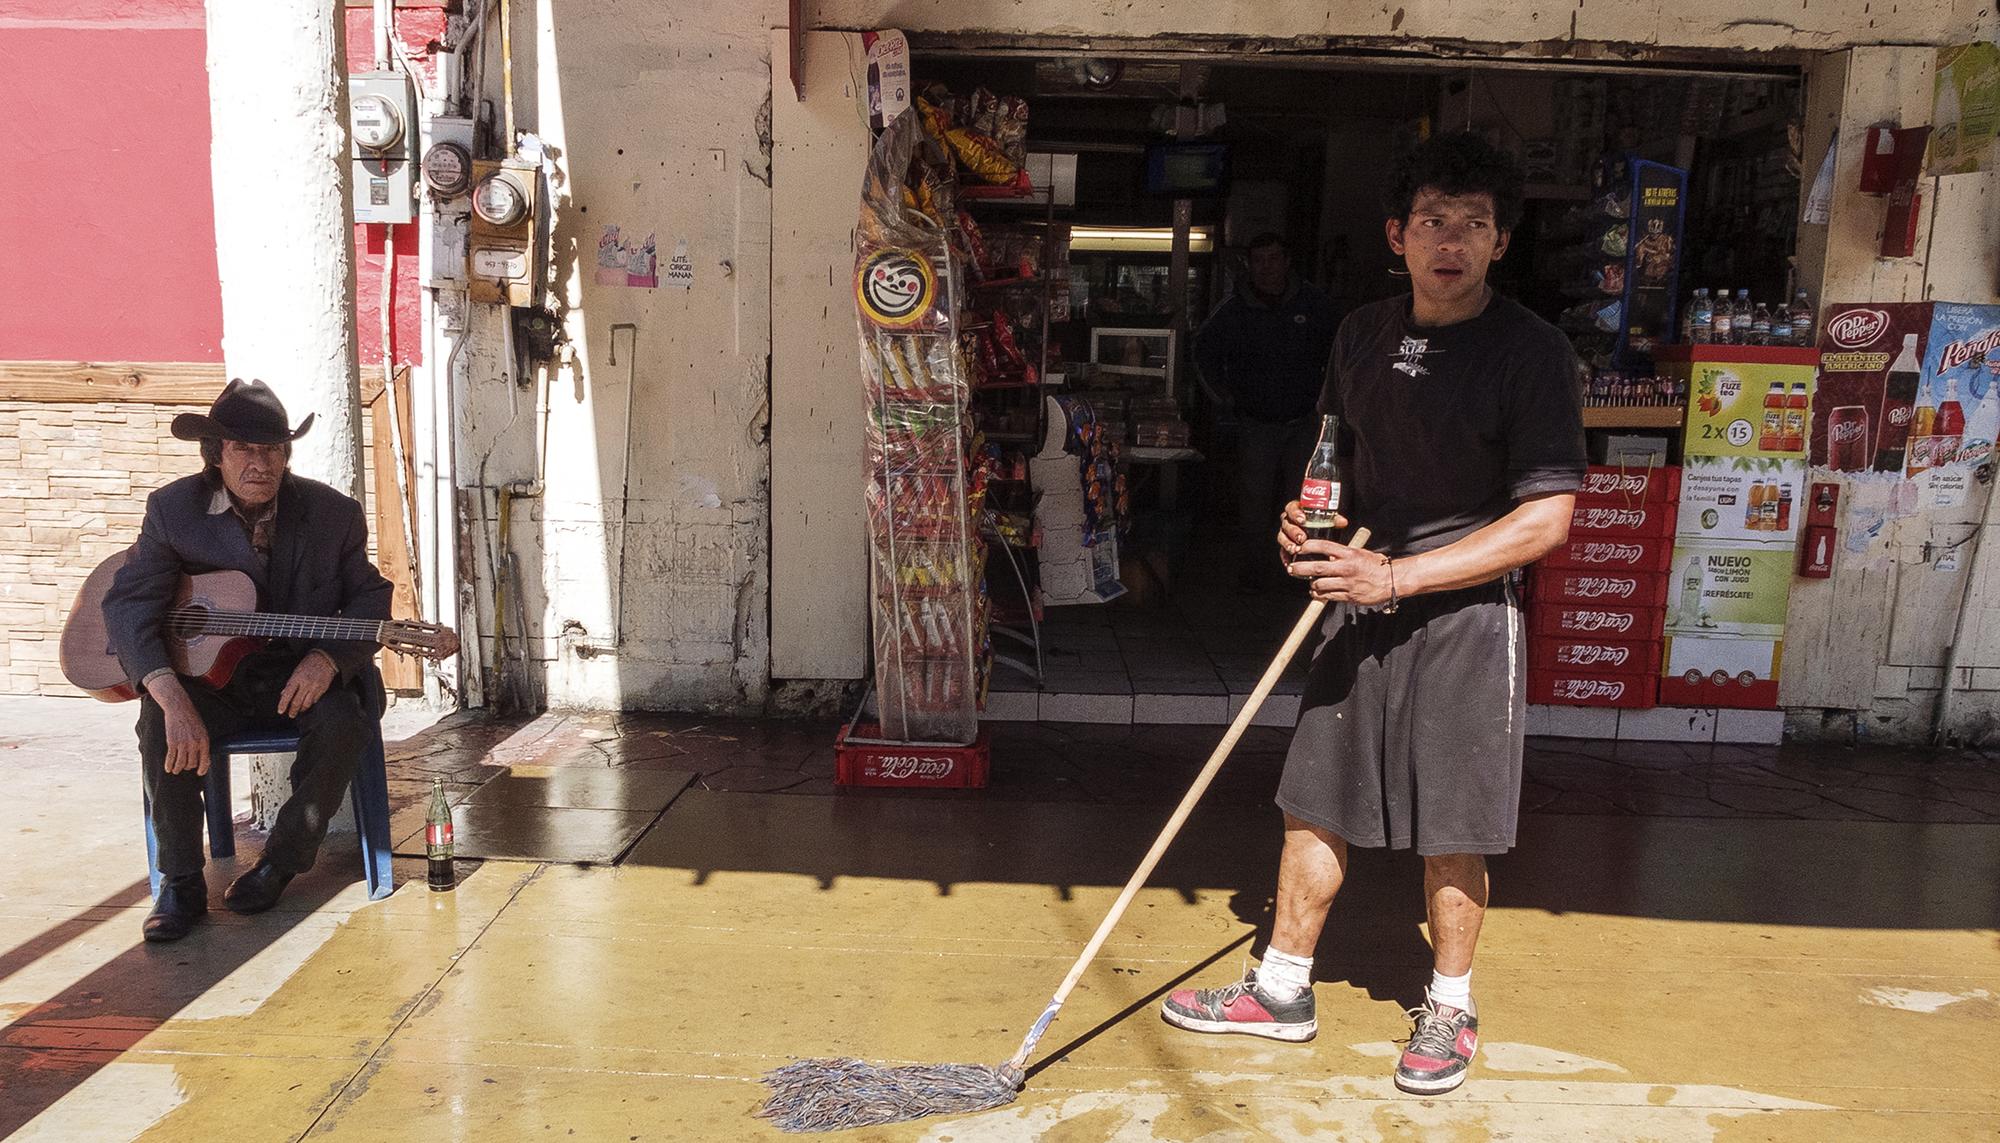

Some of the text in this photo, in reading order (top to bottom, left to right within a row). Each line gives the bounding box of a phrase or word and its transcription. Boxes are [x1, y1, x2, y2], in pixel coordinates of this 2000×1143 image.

[1852, 316, 1868, 329] Dr
[1838, 319, 1878, 341] Pepper
[1721, 382, 1741, 391] FUZE
[1708, 555, 1751, 567] NUEVO
[1725, 567, 1751, 576] LIMÓN
[879, 756, 954, 779] Coca-Cola
